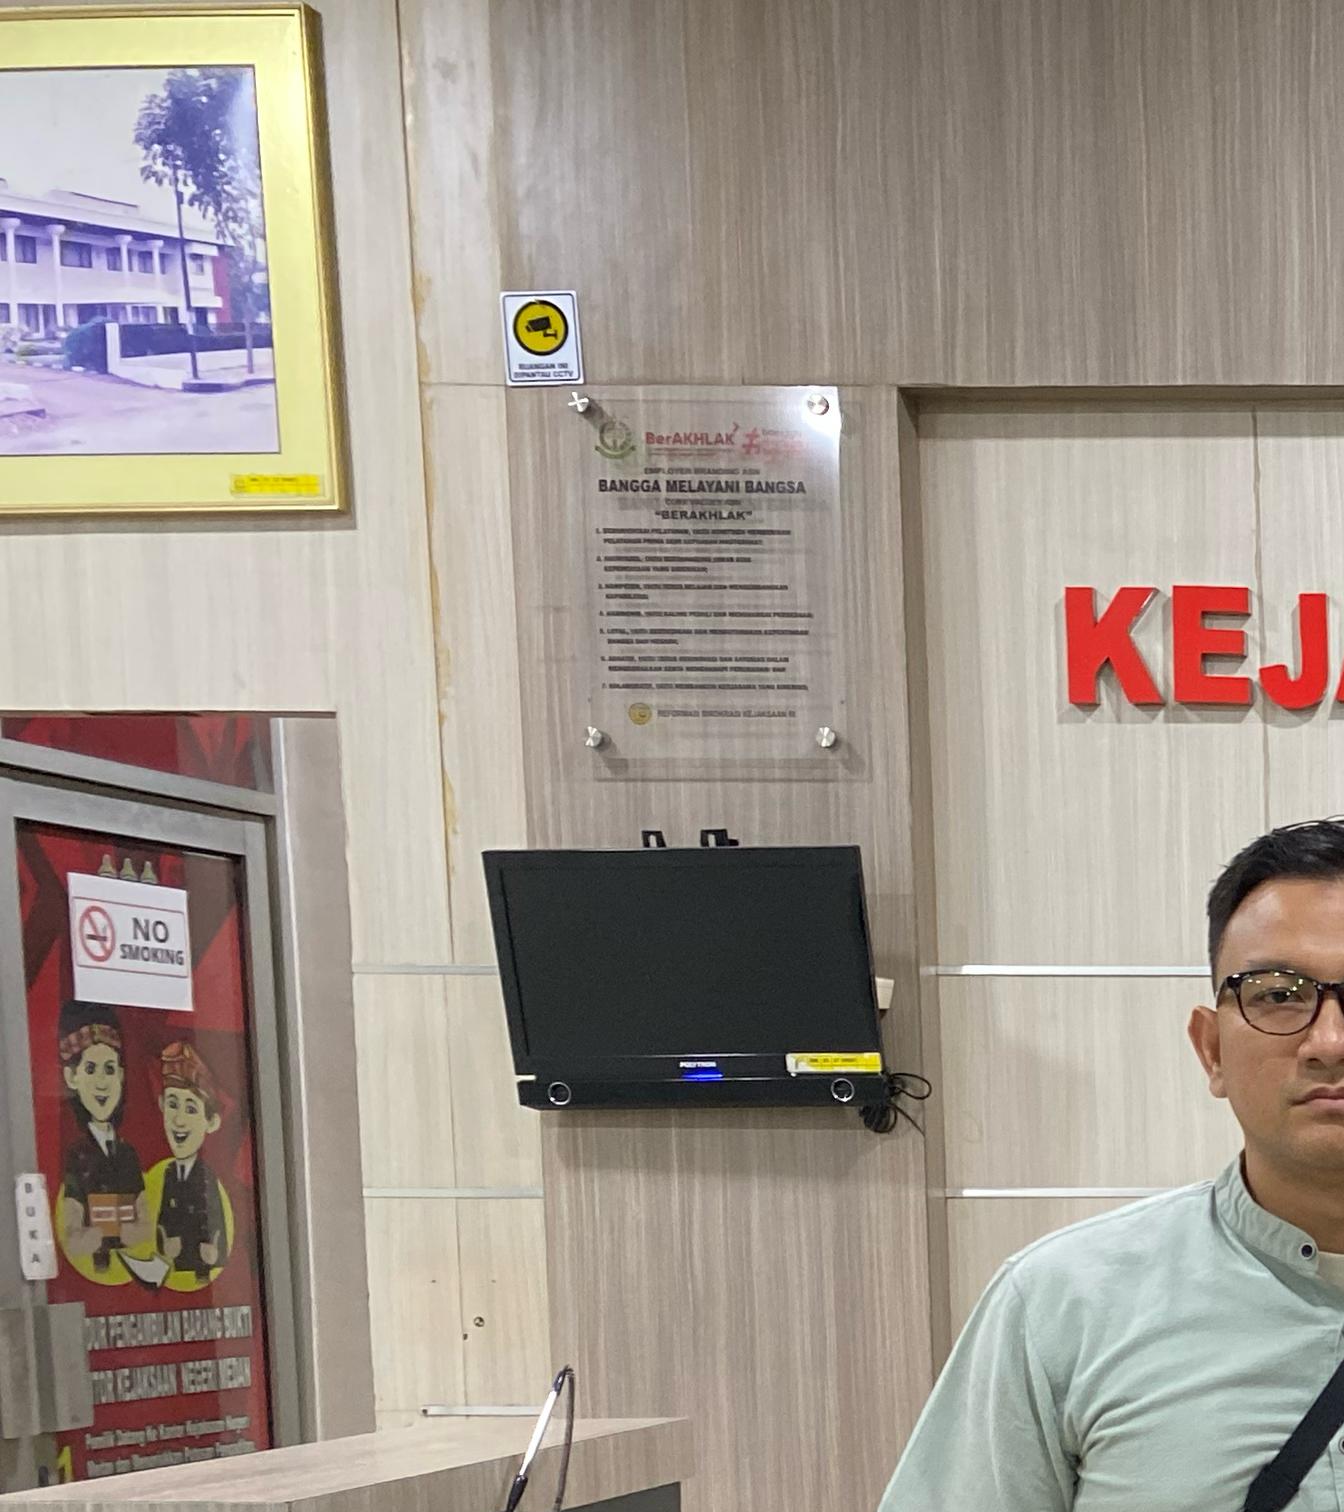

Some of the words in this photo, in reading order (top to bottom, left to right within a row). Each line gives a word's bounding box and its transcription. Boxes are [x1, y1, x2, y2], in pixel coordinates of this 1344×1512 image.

[644, 430, 736, 447] BerAKHLAK
[598, 479, 662, 493] BANGGA
[665, 479, 741, 494] MELAYANI
[744, 480, 807, 495] BANGSA
[131, 917, 170, 943] NO
[119, 943, 184, 966] SMOKING
